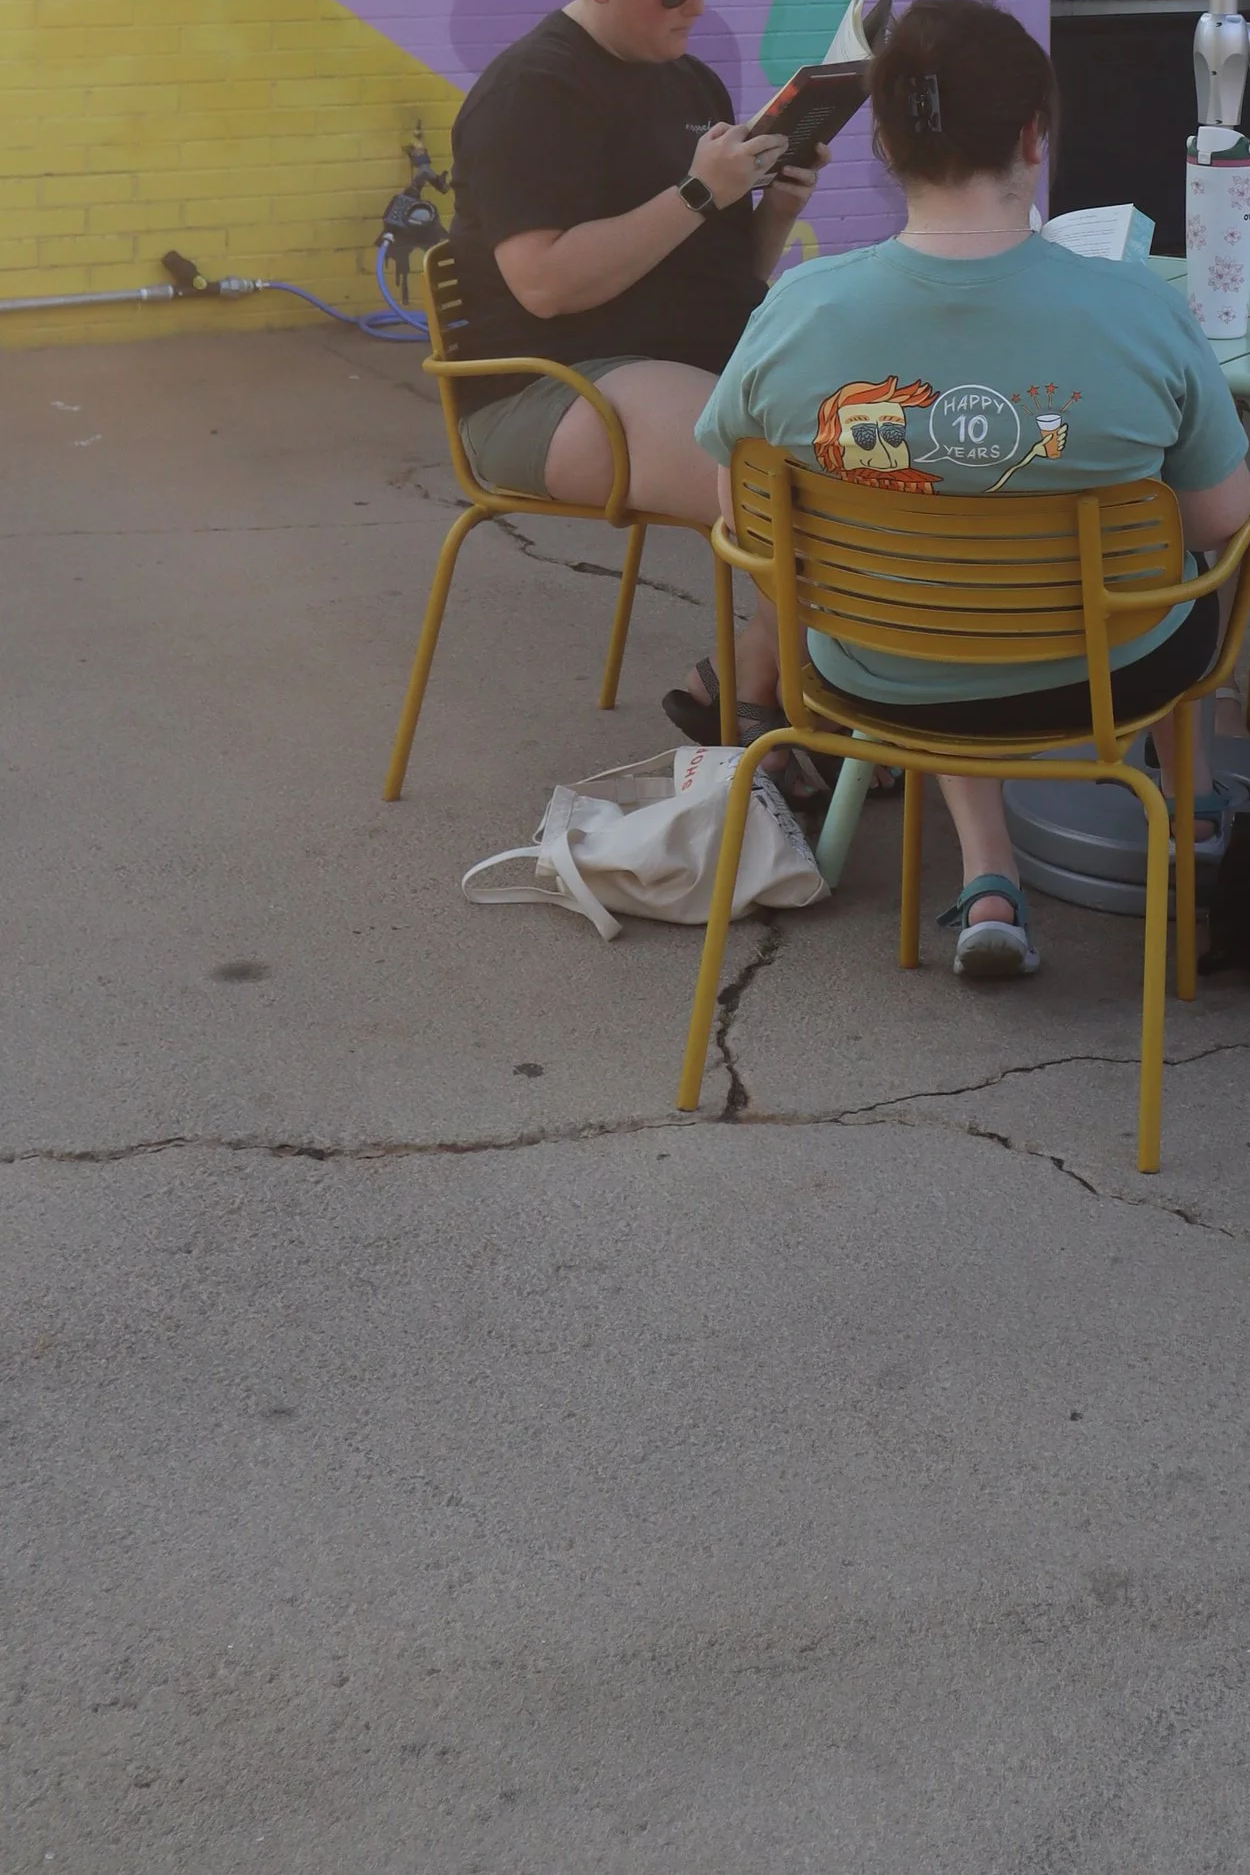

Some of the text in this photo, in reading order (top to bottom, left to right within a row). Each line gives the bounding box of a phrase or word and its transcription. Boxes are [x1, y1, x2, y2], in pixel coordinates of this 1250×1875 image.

[943, 394, 1005, 416] HAPPY
[951, 414, 989, 444] 10
[943, 444, 1001, 460] YEARS
